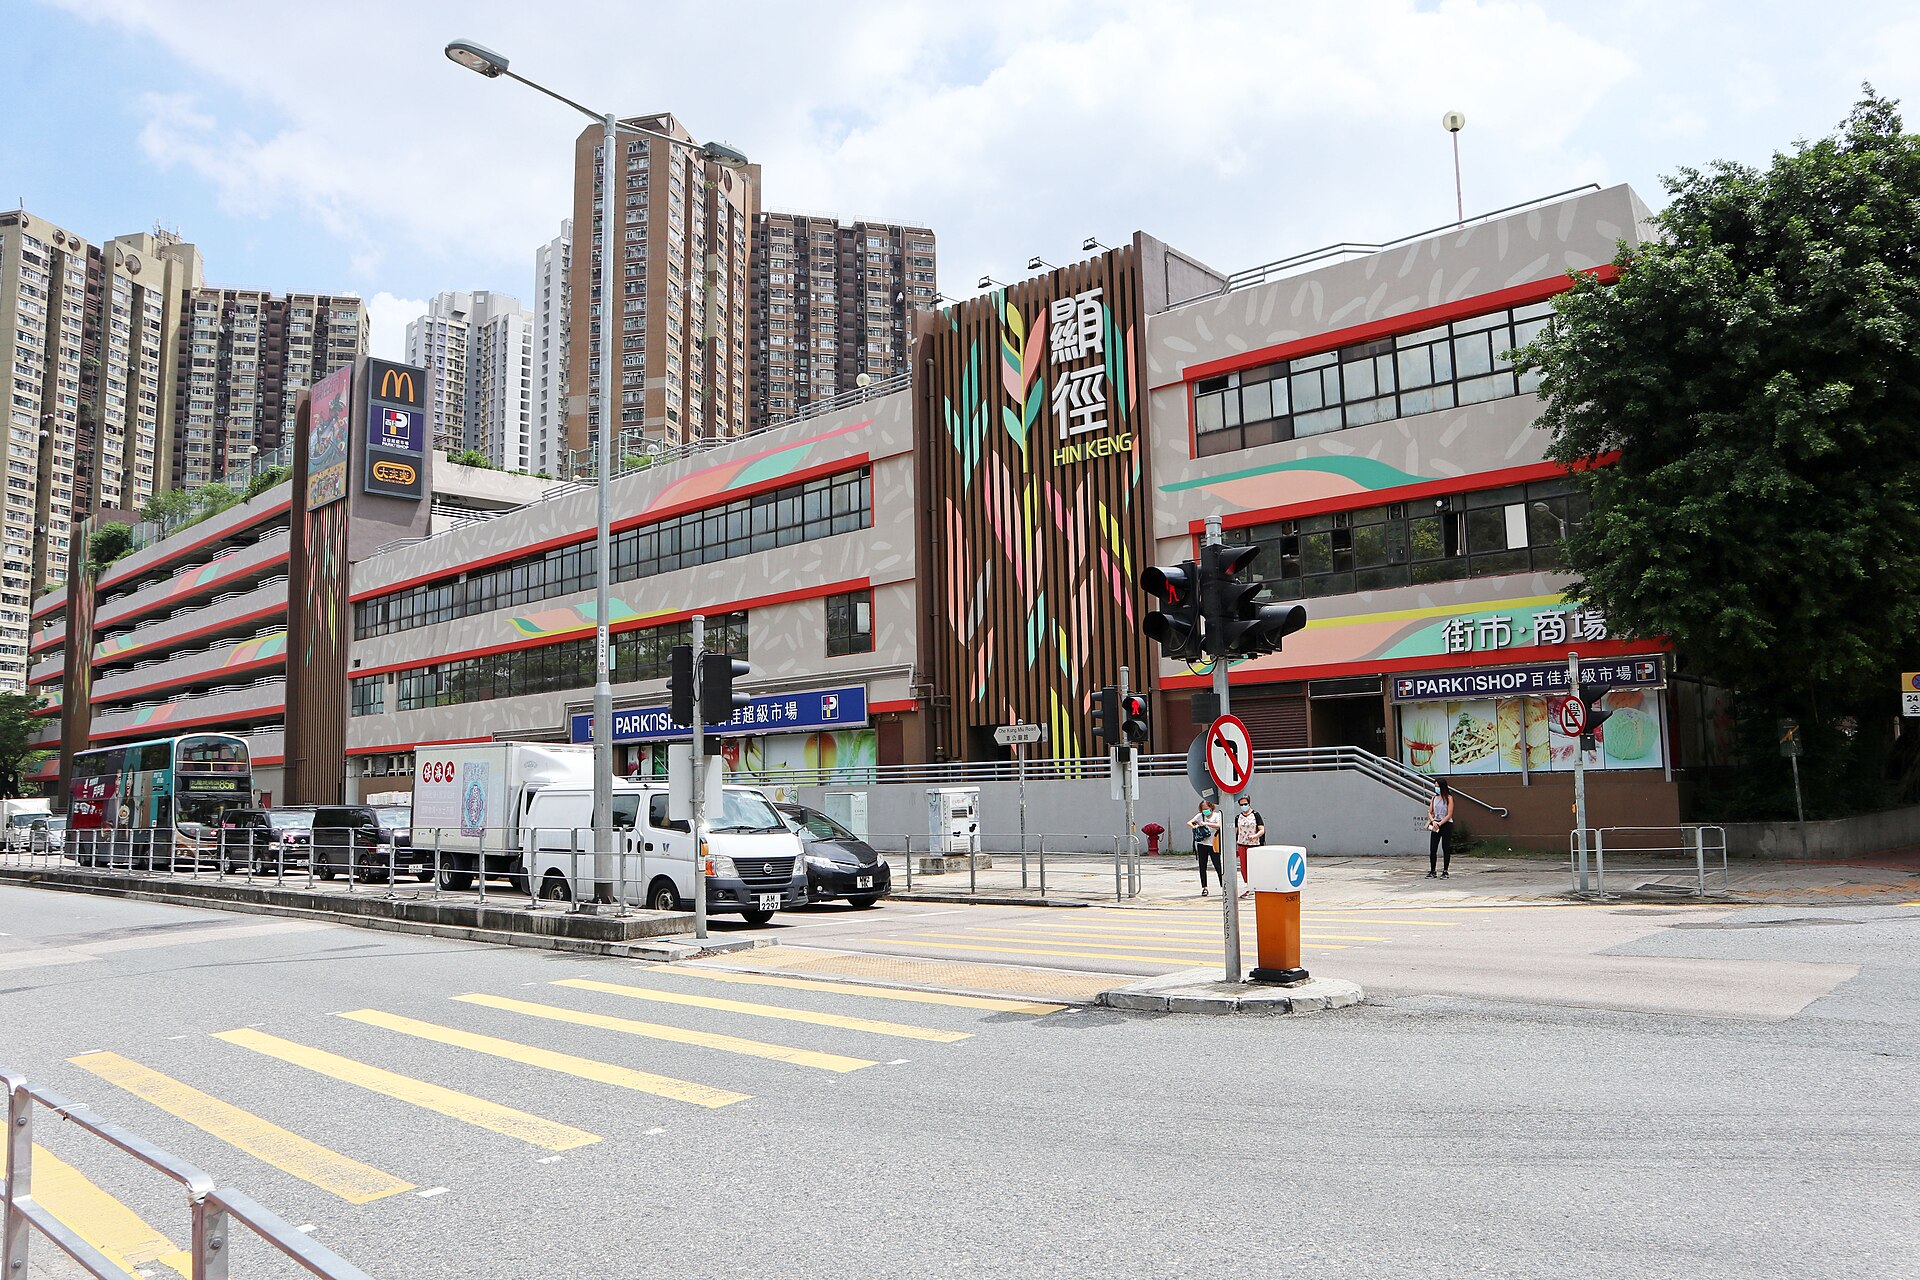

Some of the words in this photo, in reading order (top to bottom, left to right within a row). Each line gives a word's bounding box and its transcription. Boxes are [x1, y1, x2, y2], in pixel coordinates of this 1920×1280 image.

[1050, 287, 1108, 440] 顯徑
[1054, 443, 1082, 467] HIN
[1085, 432, 1132, 459] KENG
[1417, 672, 1527, 695] PARKnSHOP
[616, 712, 692, 735] PARKnSH
[718, 701, 798, 727] 佳超級市場
[761, 902, 779, 910] 2297
